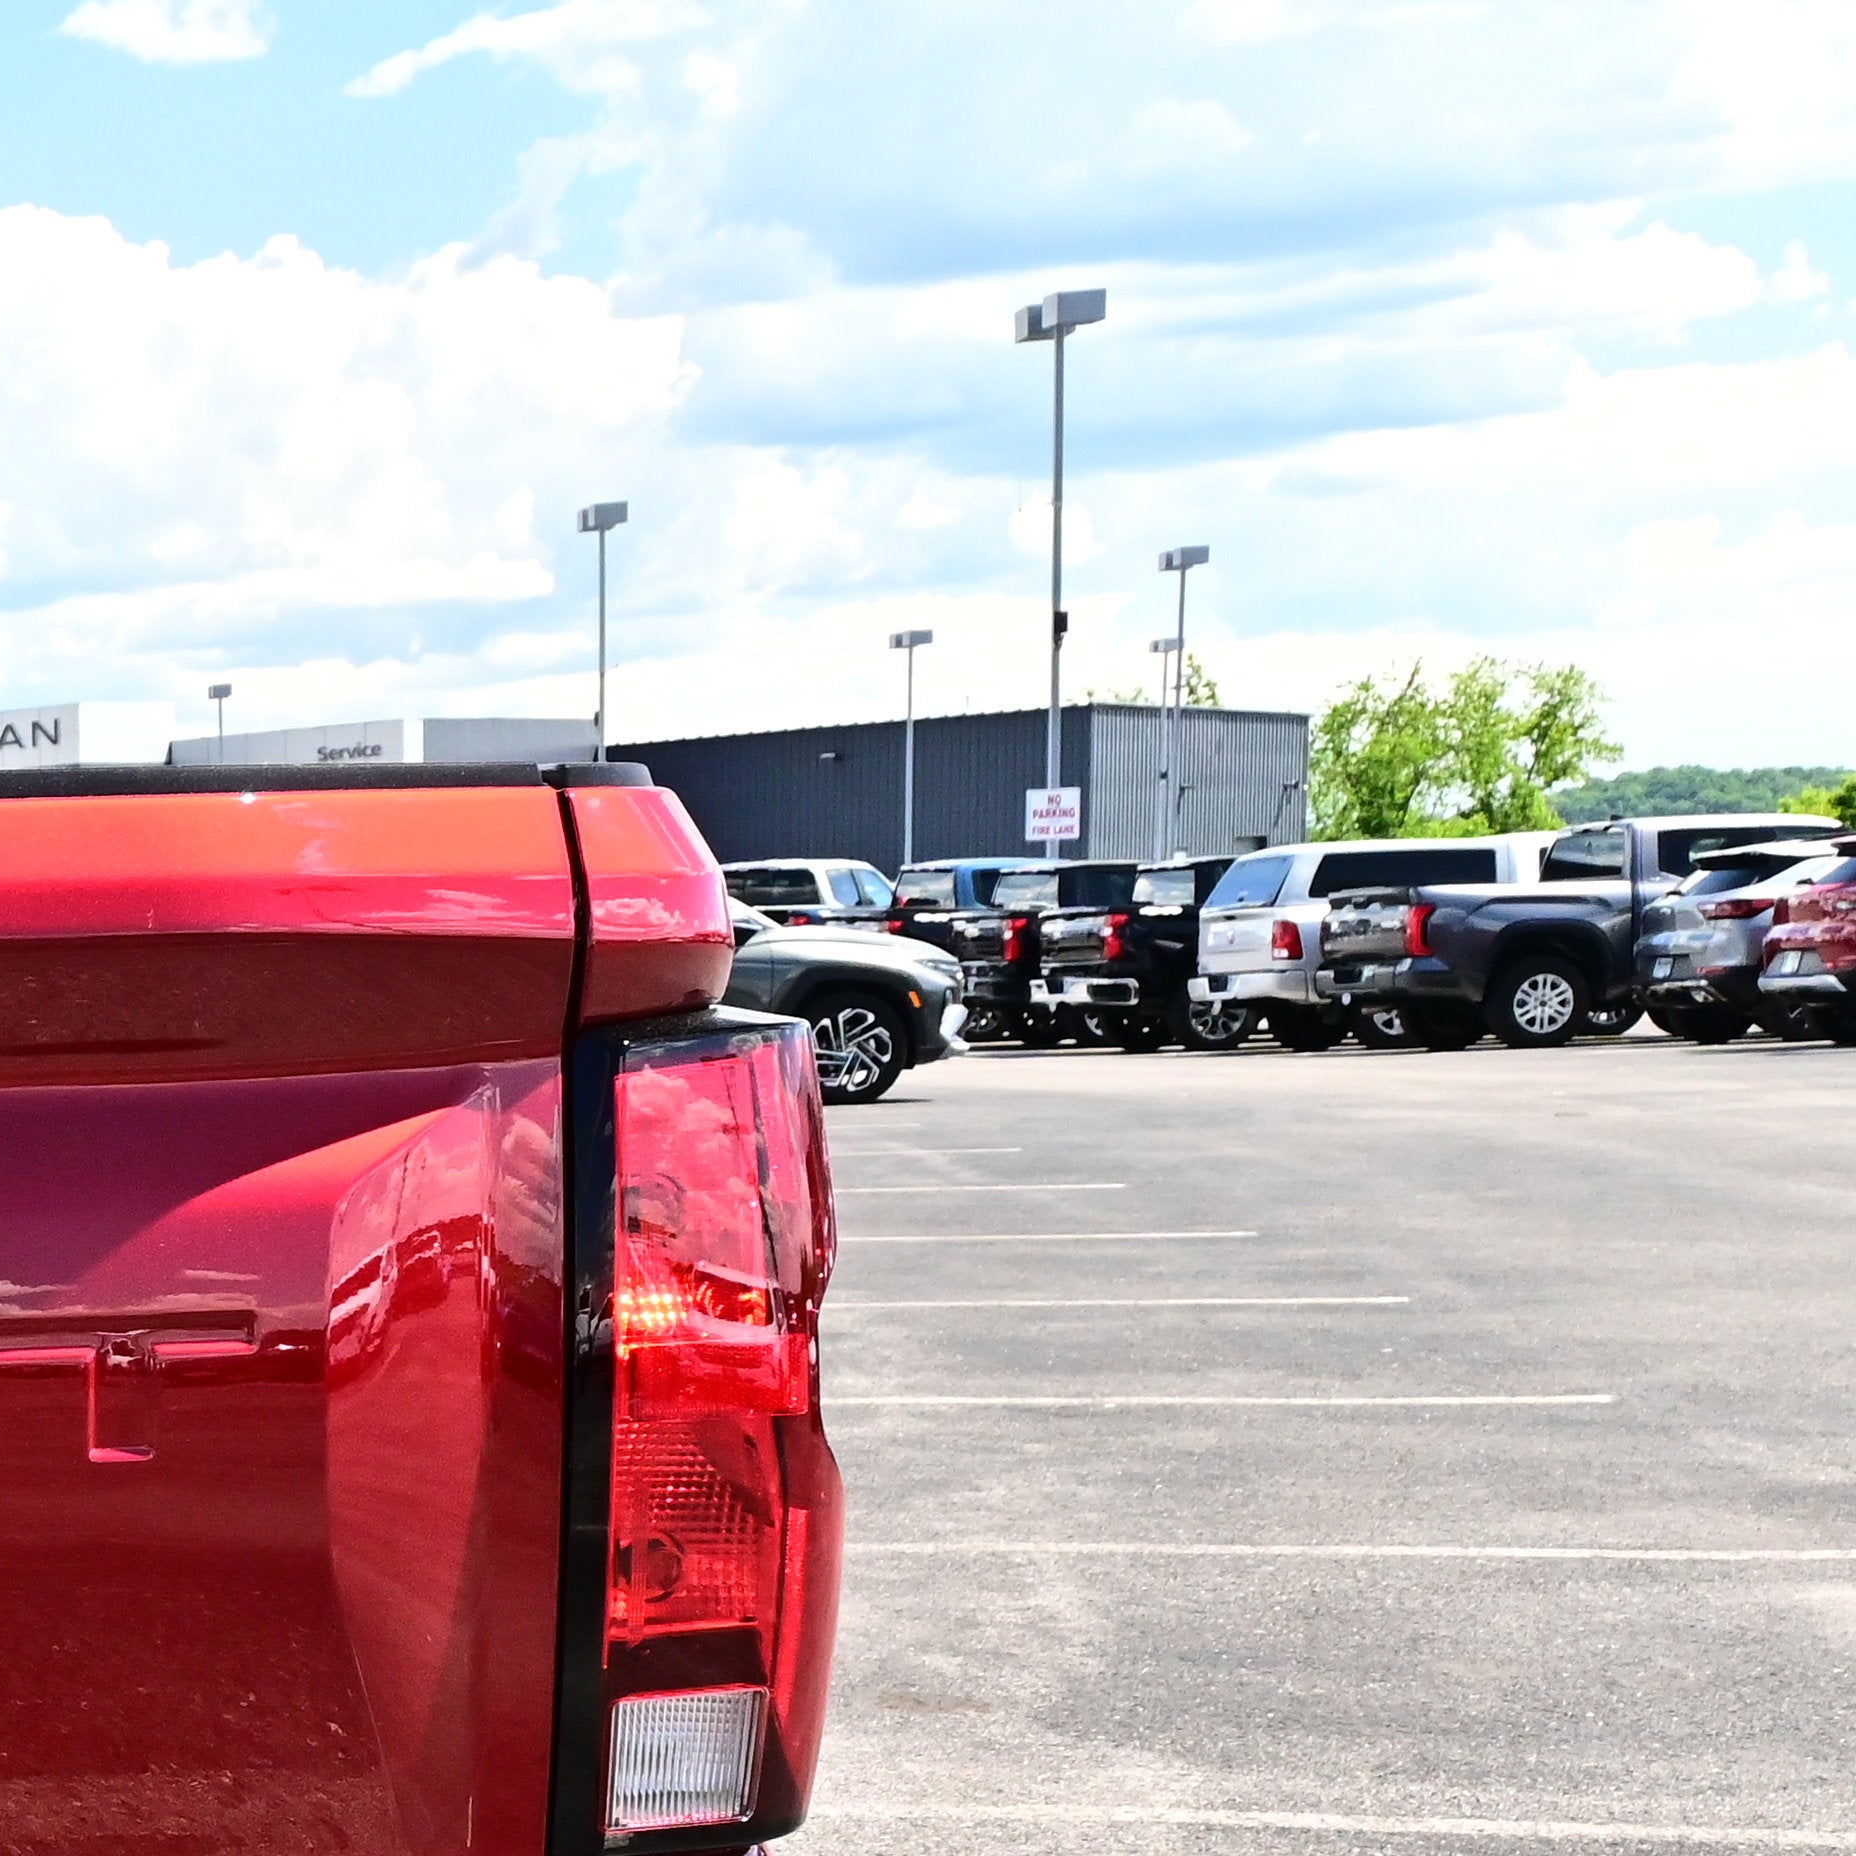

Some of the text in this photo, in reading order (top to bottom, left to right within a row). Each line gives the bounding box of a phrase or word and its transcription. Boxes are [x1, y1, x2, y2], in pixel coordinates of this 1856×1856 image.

[317, 742, 382, 761] Service
[1048, 795, 1062, 806] NO
[1032, 807, 1076, 819] PARKING
[1032, 824, 1075, 835] FIRE LANE
